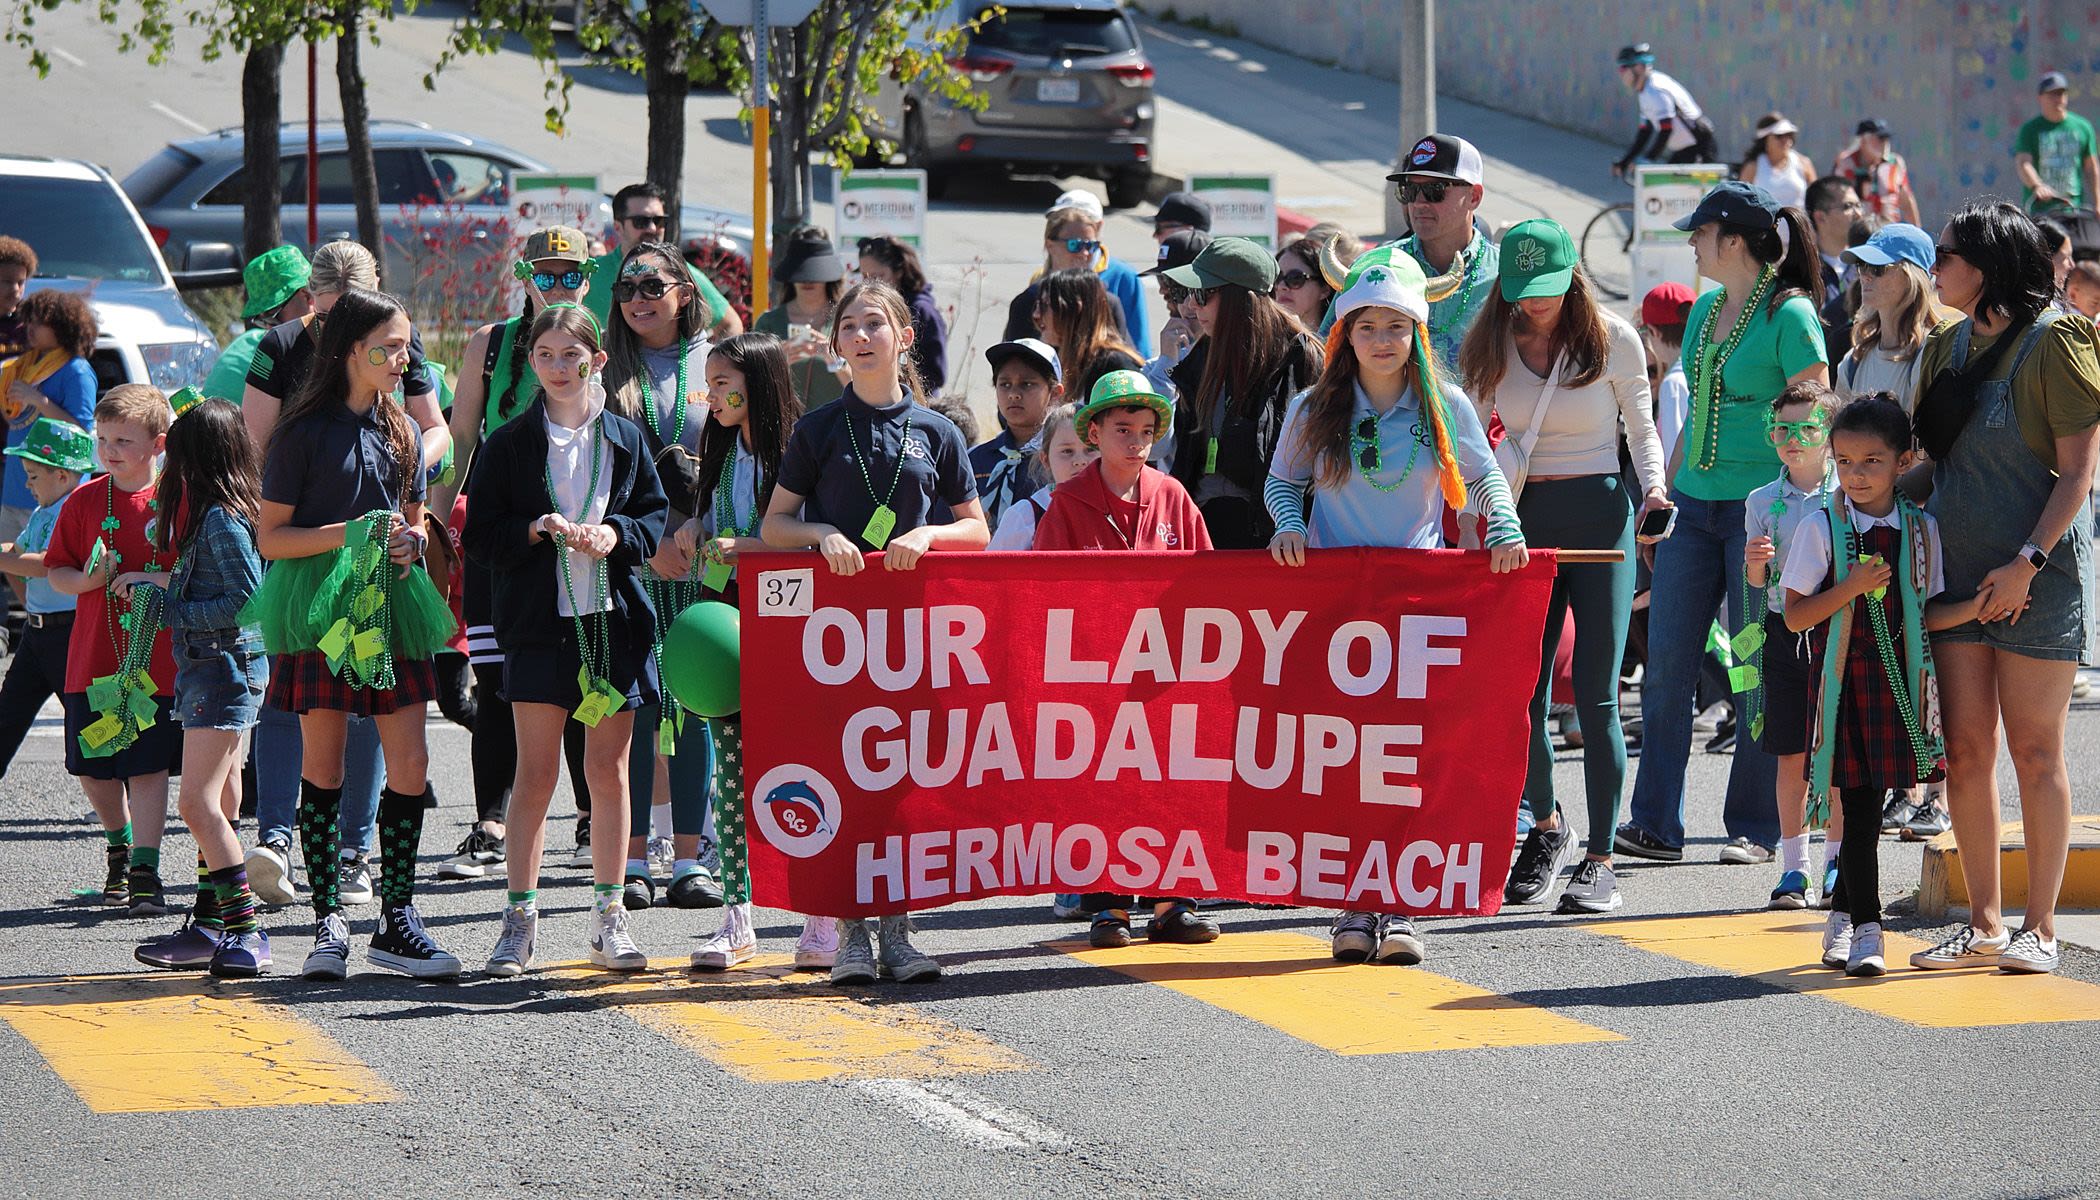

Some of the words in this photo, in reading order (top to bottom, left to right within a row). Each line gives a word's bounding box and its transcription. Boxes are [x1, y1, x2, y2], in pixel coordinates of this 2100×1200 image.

[864, 202, 915, 214] MERIDIAN
[1845, 531, 1856, 560] YOU
[764, 578, 803, 607] 37
[802, 604, 991, 692] OUR
[1043, 607, 1309, 686] LADY
[1327, 614, 1467, 699] OF
[841, 701, 1423, 808] GUADALUPE
[855, 822, 1218, 904] HERMOSA
[1246, 830, 1484, 910] BEACH
